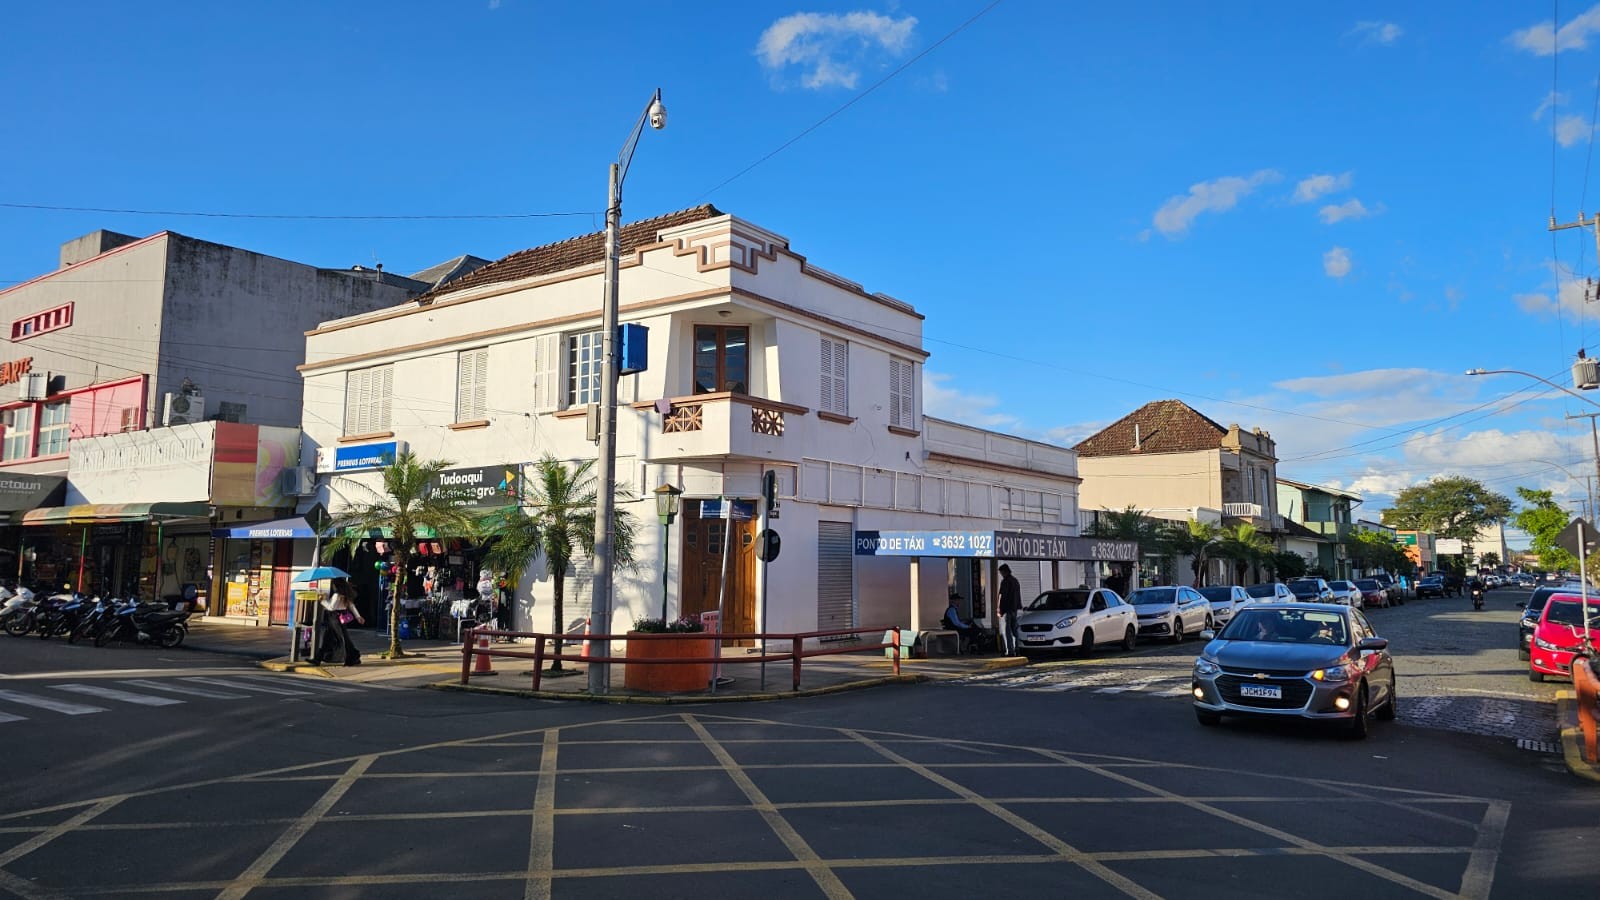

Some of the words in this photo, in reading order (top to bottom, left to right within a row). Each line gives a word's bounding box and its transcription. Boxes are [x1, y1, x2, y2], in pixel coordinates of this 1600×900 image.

[439, 470, 483, 485] Tudoaqui
[857, 538, 887, 550] PONTO
[889, 538, 902, 550] DE
[904, 535, 925, 550] TÁXI
[941, 535, 965, 549] 3632
[968, 535, 992, 549] 1027
[995, 537, 1031, 556] PONTO
[1033, 539, 1045, 557] DE
[1047, 537, 1067, 557] TÁXI
[1097, 542, 1115, 559] 3632
[1115, 543, 1132, 560] 1027
